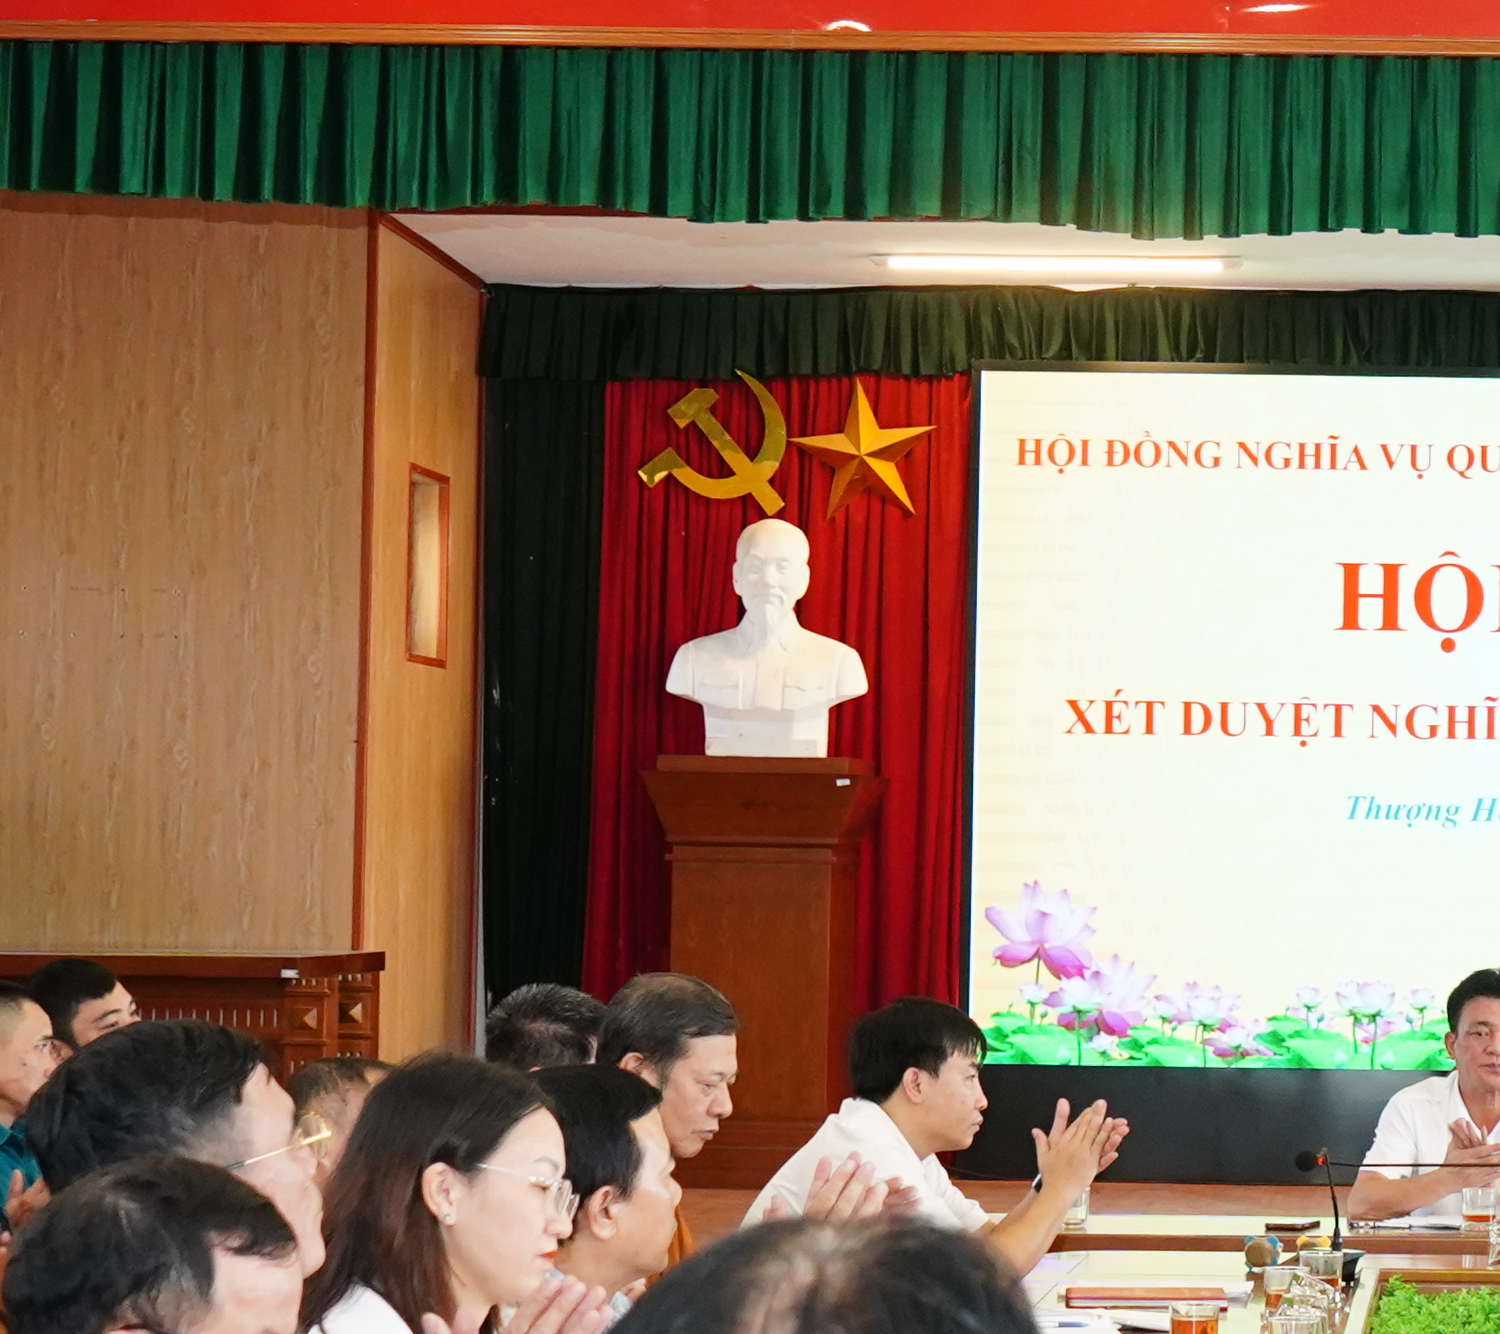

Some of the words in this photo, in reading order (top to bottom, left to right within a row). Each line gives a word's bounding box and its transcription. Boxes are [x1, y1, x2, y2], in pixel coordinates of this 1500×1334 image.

[1014, 433, 1092, 475] HỘI
[1103, 431, 1223, 469] ĐỒNG
[1236, 435, 1369, 471] NGHĨA
[1379, 443, 1434, 479] VỤ
[1063, 688, 1166, 735] XÉT
[1180, 697, 1355, 747] DUYỆT
[1347, 793, 1462, 829] Thượng
